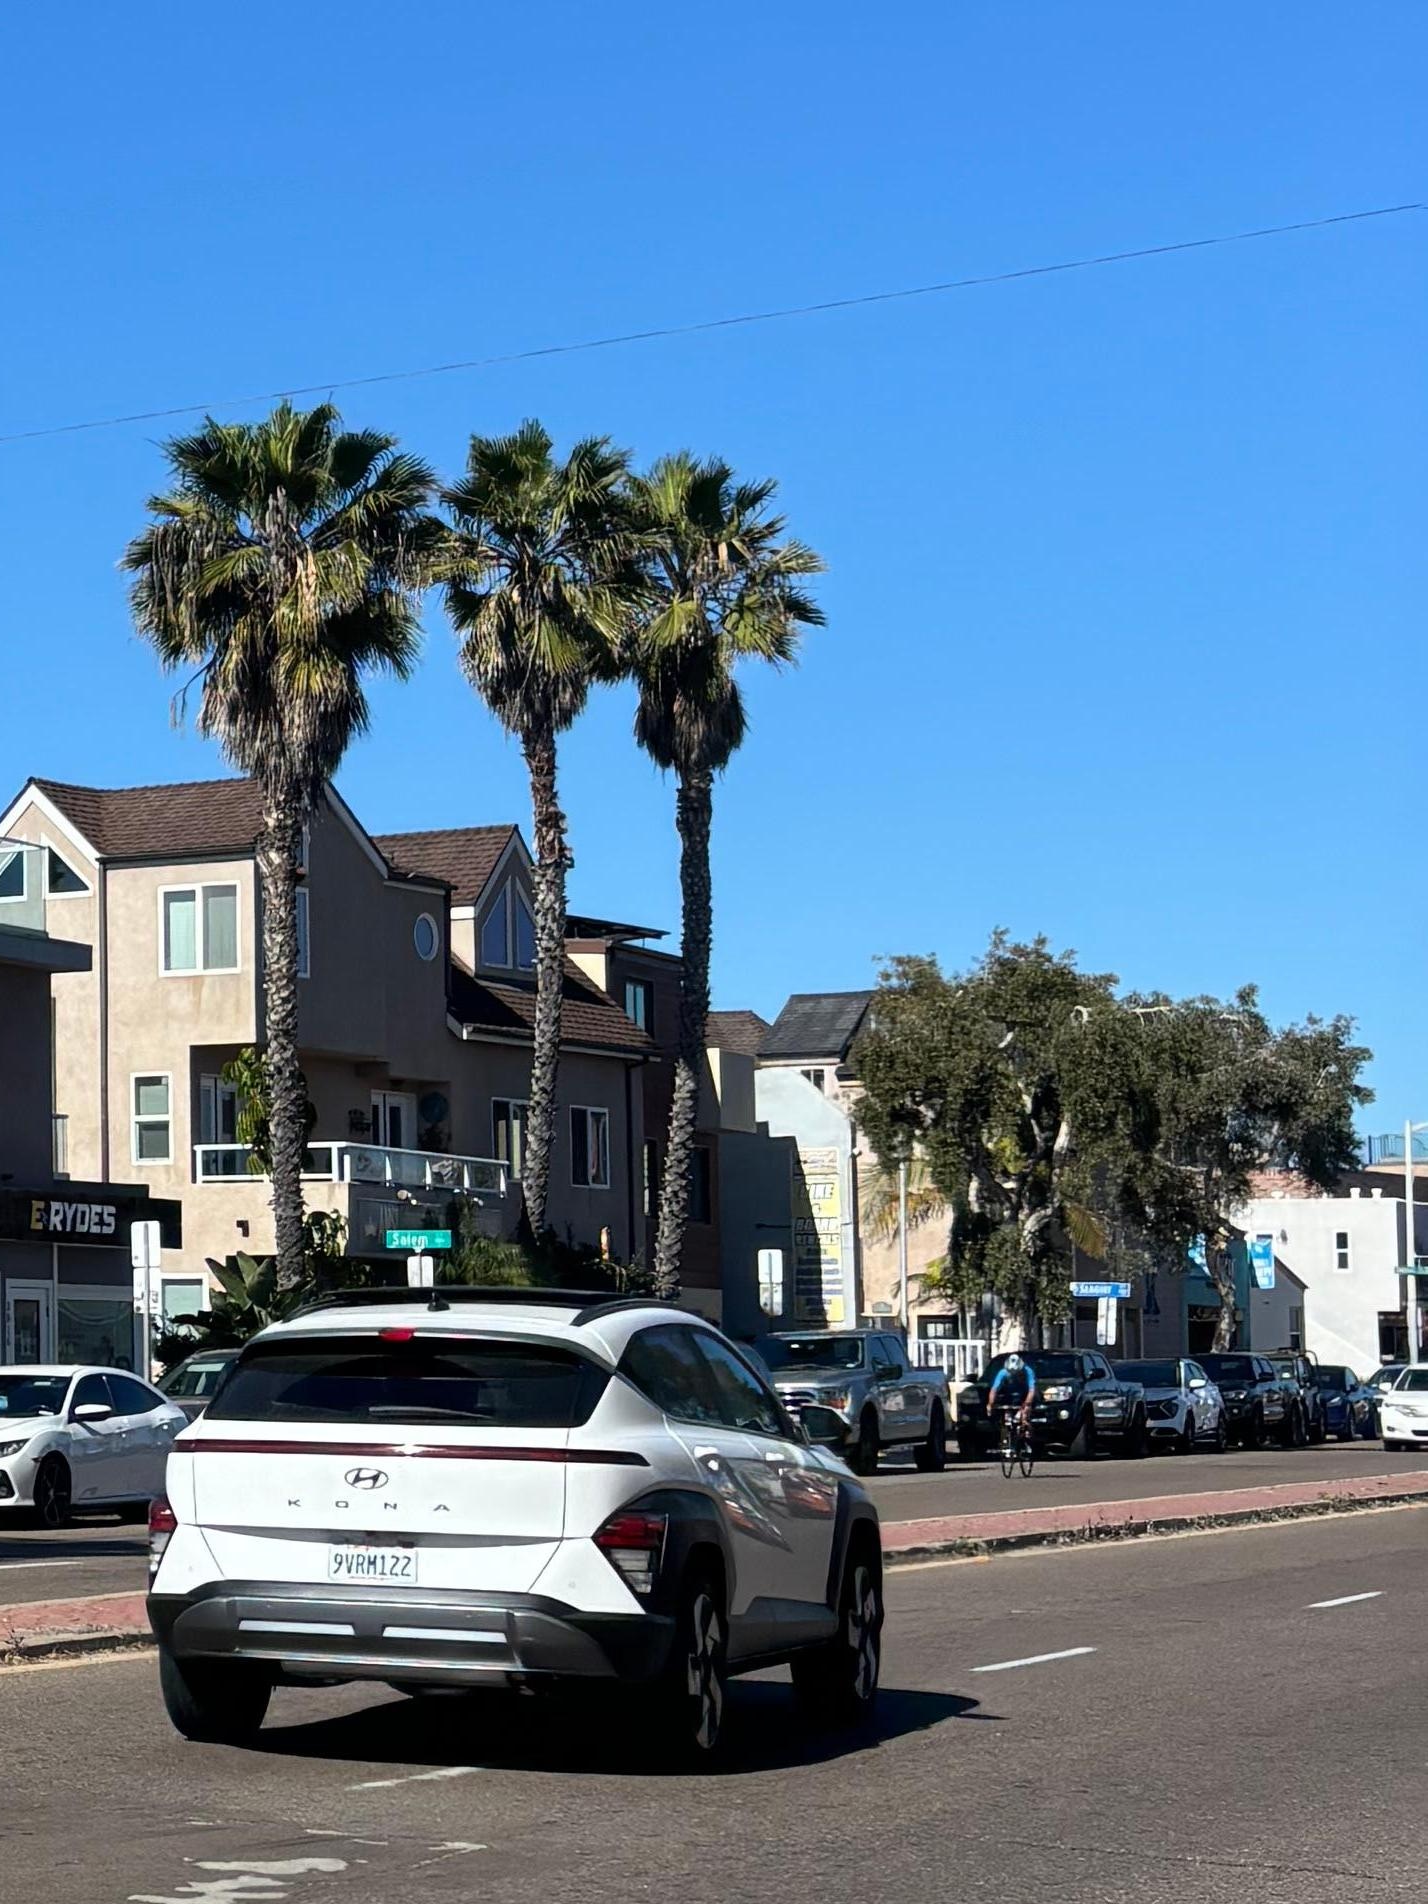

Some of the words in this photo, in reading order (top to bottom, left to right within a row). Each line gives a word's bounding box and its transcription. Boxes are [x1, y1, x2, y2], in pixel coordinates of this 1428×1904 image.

[391, 1232, 429, 1247] Salem
[287, 1498, 451, 1512] KONA
[332, 1552, 413, 1577] 9VRM122
